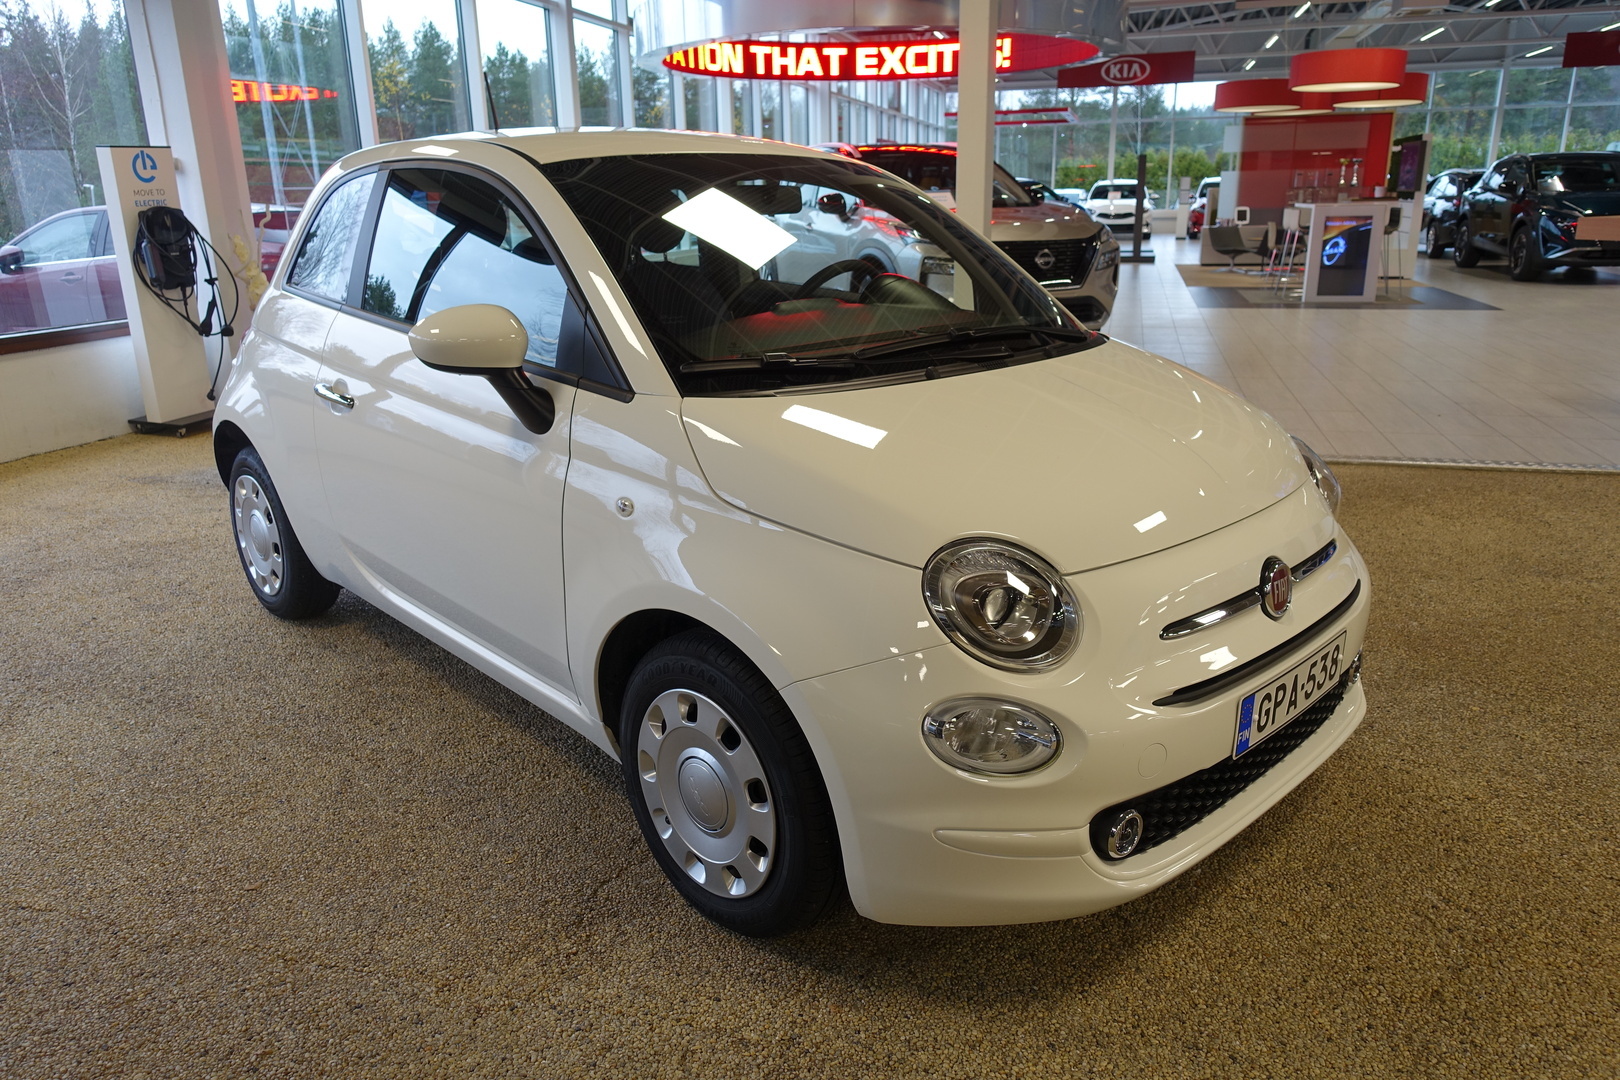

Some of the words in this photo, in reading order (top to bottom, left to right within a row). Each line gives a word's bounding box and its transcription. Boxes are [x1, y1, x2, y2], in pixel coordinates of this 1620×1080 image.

[750, 45, 848, 76] THAT
[855, 38, 1012, 76] EXCIT!
[1109, 63, 1142, 79] KIA
[133, 188, 154, 197] MOVE
[155, 188, 166, 196] TO
[134, 199, 168, 207] ELECTRIC
[1273, 575, 1289, 604] FIAT
[1256, 643, 1341, 733] GPA-538
[1237, 727, 1251, 747] FIN
